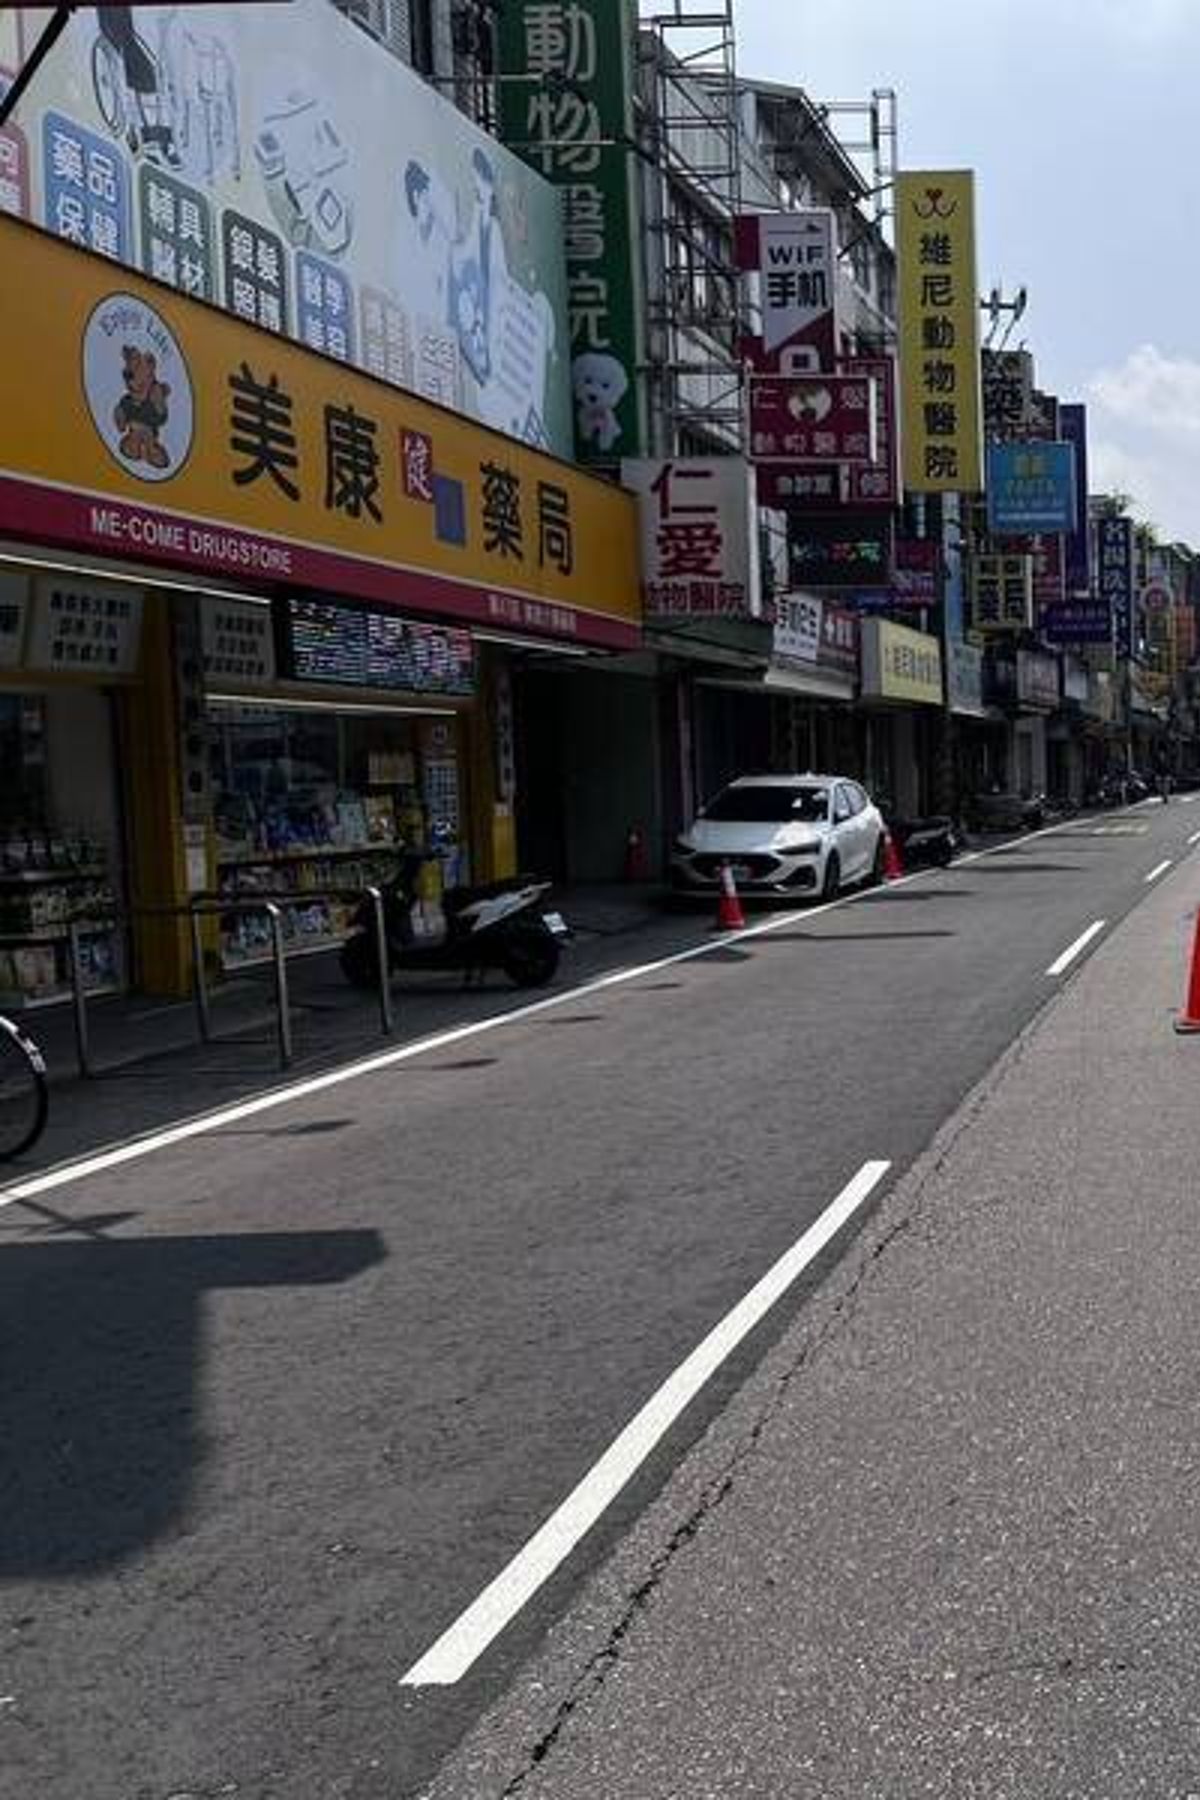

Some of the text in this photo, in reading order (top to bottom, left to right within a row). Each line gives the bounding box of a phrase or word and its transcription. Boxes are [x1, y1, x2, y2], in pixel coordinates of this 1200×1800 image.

[52, 131, 117, 202] 藥品
[918, 231, 958, 478] 維尼動物醫院
[227, 361, 383, 524] 美康
[403, 433, 433, 501] 健
[479, 460, 575, 577] 藥局
[650, 463, 723, 580] 仁愛
[90, 506, 292, 574] ME-COME DRUGSTORE
